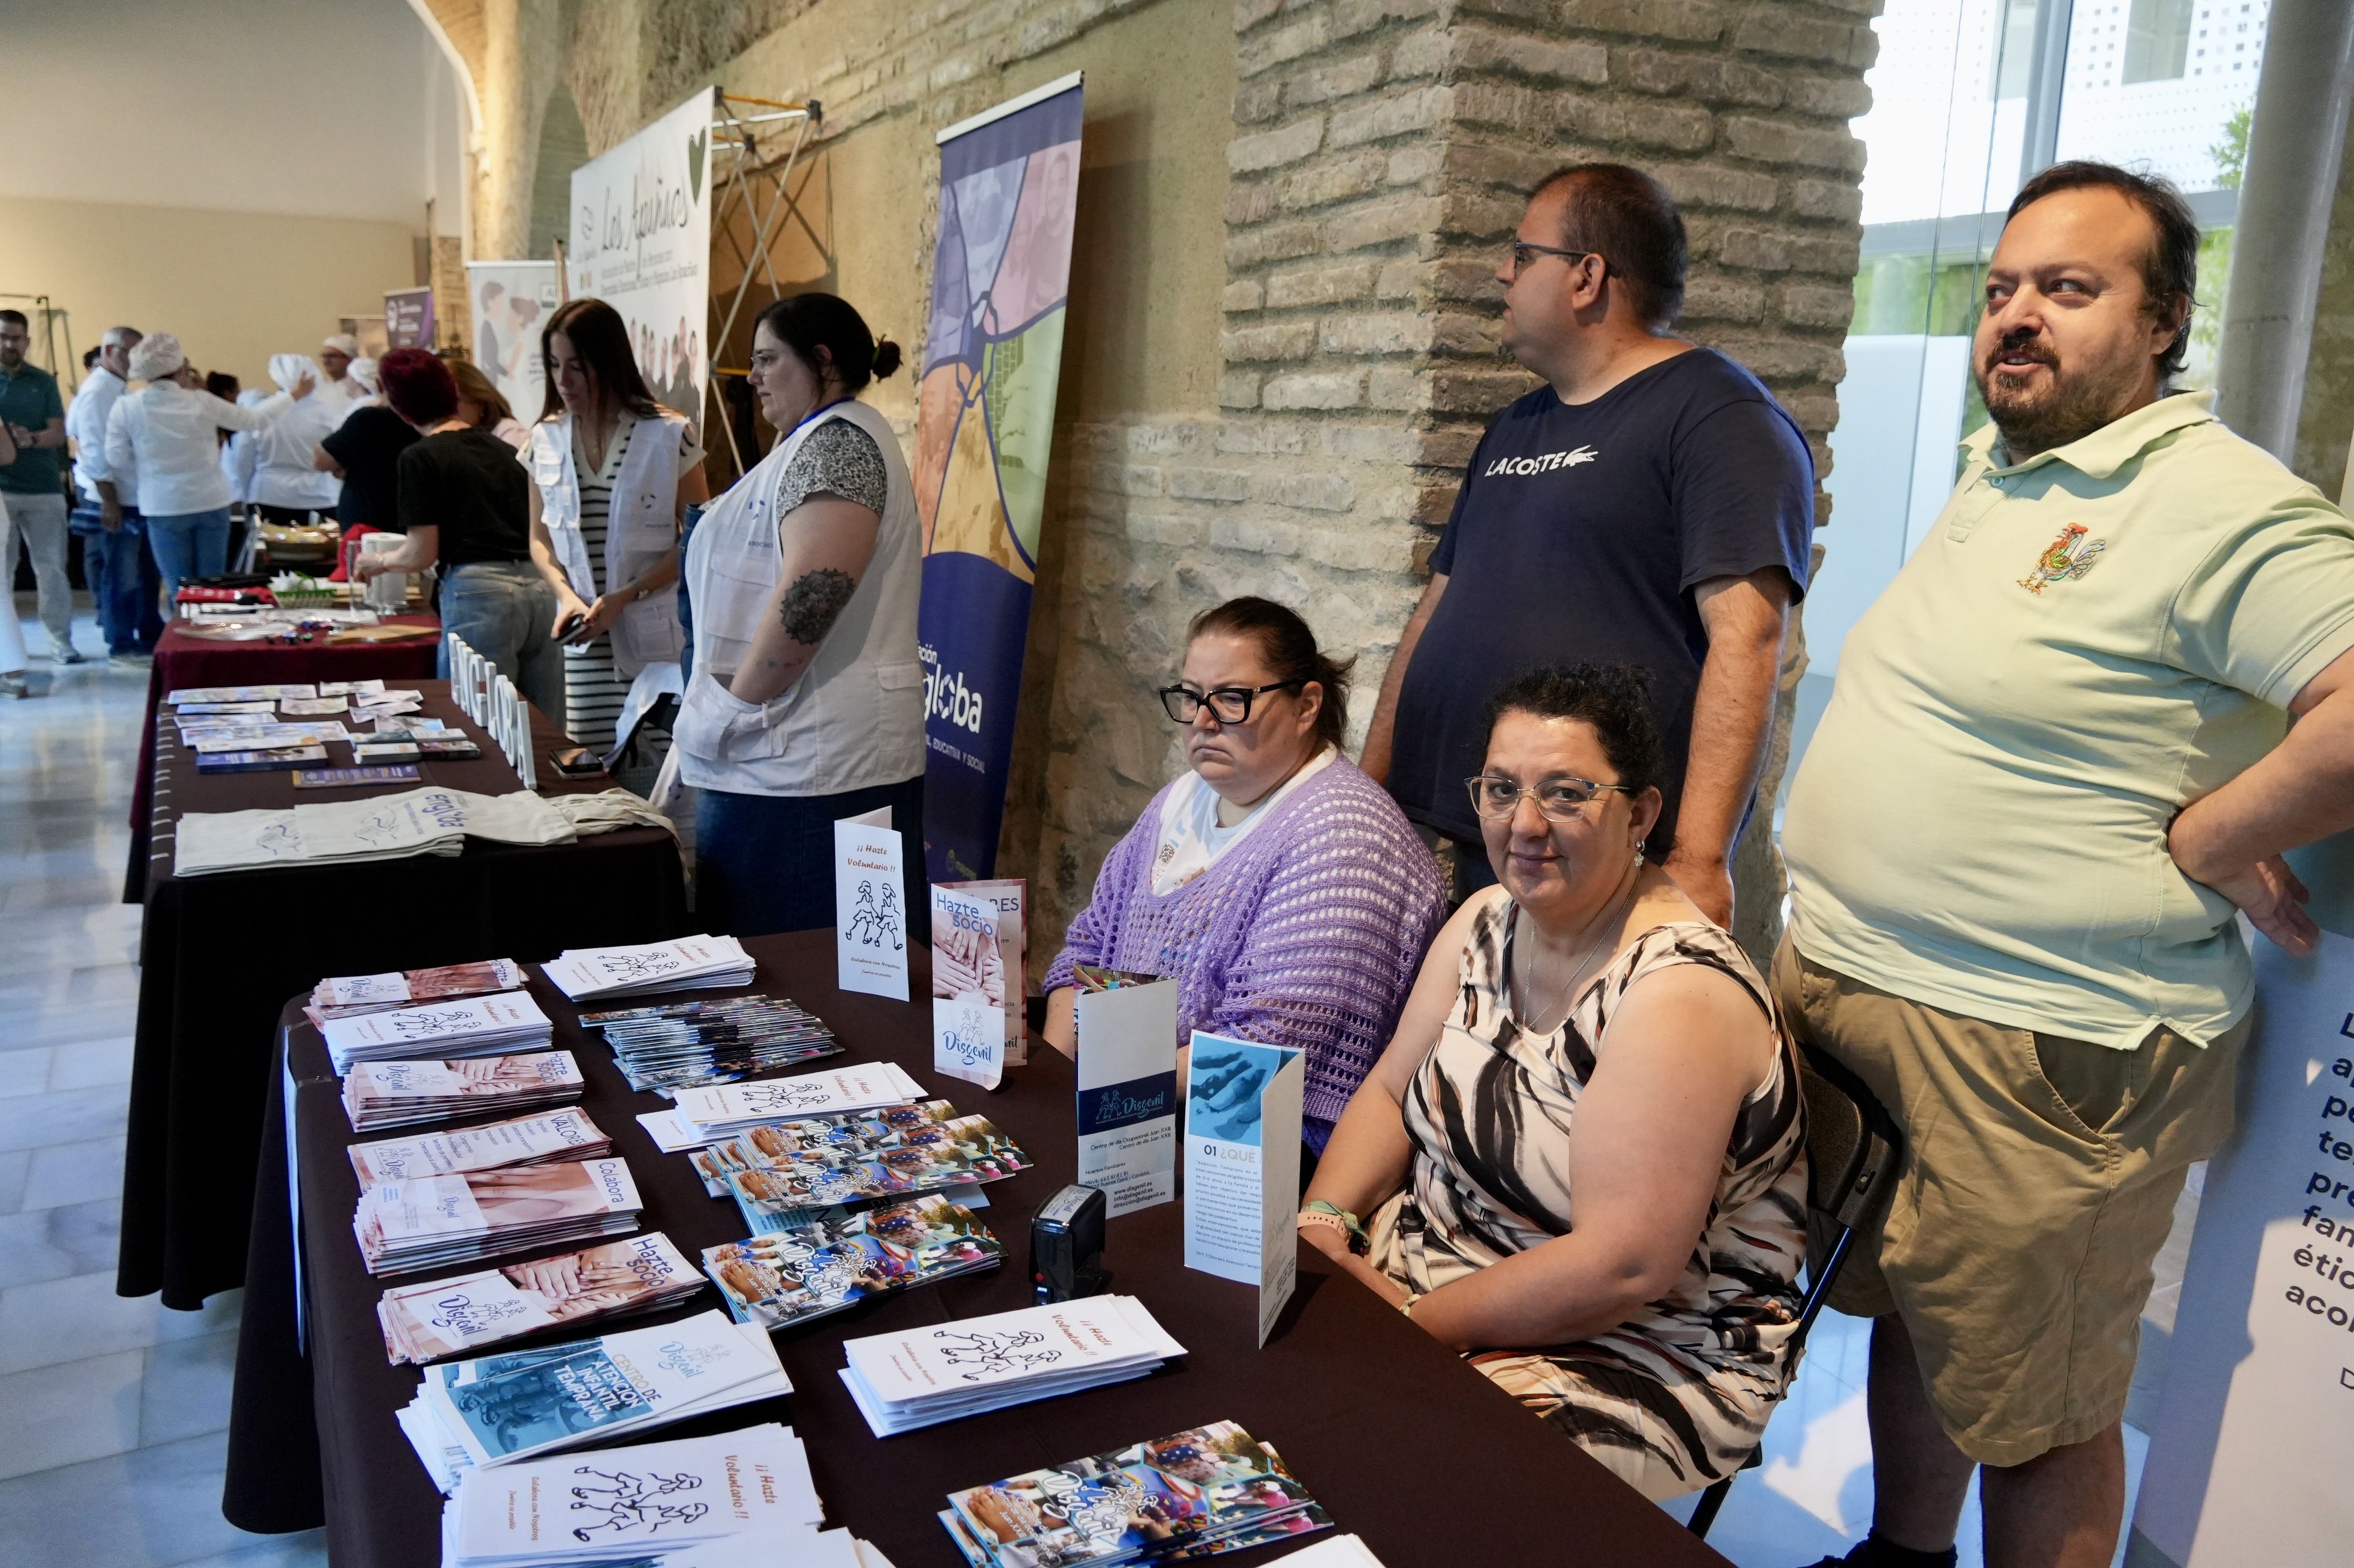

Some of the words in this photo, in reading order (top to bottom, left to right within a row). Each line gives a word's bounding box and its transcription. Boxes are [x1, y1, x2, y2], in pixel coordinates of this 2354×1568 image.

[1484, 451, 1567, 477] LACOSTE
[866, 845, 887, 855] Hazte
[848, 858, 888, 871] Voluntario
[937, 892, 979, 919] Hazte
[943, 1031, 991, 1065] Disgenil
[548, 1052, 568, 1075] Hazte
[376, 1064, 412, 1090] Disgenil
[833, 1076, 852, 1096] Voluntario
[858, 1082, 871, 1093] Hazte
[1122, 1091, 1164, 1118] Disgenil
[1123, 1133, 1149, 1143] Ocupacional
[1104, 1162, 1125, 1171] Familiares
[1204, 1145, 1216, 1156] 01
[1220, 1149, 1255, 1163] ¿QUÉ
[599, 1163, 623, 1202] Colabora
[1196, 1168, 1226, 1177] intervenciones
[1113, 1191, 1166, 1209] direccion@disgenil.es
[1114, 1181, 1152, 1195] www.disgenil.es
[1114, 1187, 1153, 1202] info@disgenil.es
[1200, 1197, 1226, 1206] permanentes
[633, 1238, 673, 1275] Hazte
[743, 1258, 758, 1274] Centro
[782, 1242, 846, 1297] Disgenil
[627, 1259, 665, 1286] socio
[747, 1277, 758, 1288] Juan
[761, 1265, 776, 1282] Centro
[432, 1294, 488, 1337] Disgenil
[1052, 1315, 1087, 1351] Voluntario
[1089, 1327, 1113, 1346] Hazte
[658, 1341, 705, 1380] Disgenil
[577, 1367, 620, 1411] INFANTIL
[612, 1353, 649, 1390] CENTRO
[641, 1388, 662, 1402] DE
[554, 1364, 607, 1422] TEMPRANA
[532, 1477, 540, 1501] Colabora
[724, 1455, 743, 1508] Voluntario
[760, 1474, 775, 1504] Hazte
[999, 1511, 1013, 1524] Juan
[1016, 1497, 1036, 1519] Centro
[1033, 1517, 1042, 1526] de
[1042, 1470, 1121, 1540] Disgenil
[531, 1514, 540, 1541] Nosotros
[994, 1487, 1013, 1510] Centro
[1011, 1508, 1020, 1516] de
[1024, 1523, 1056, 1559] ocupacional
